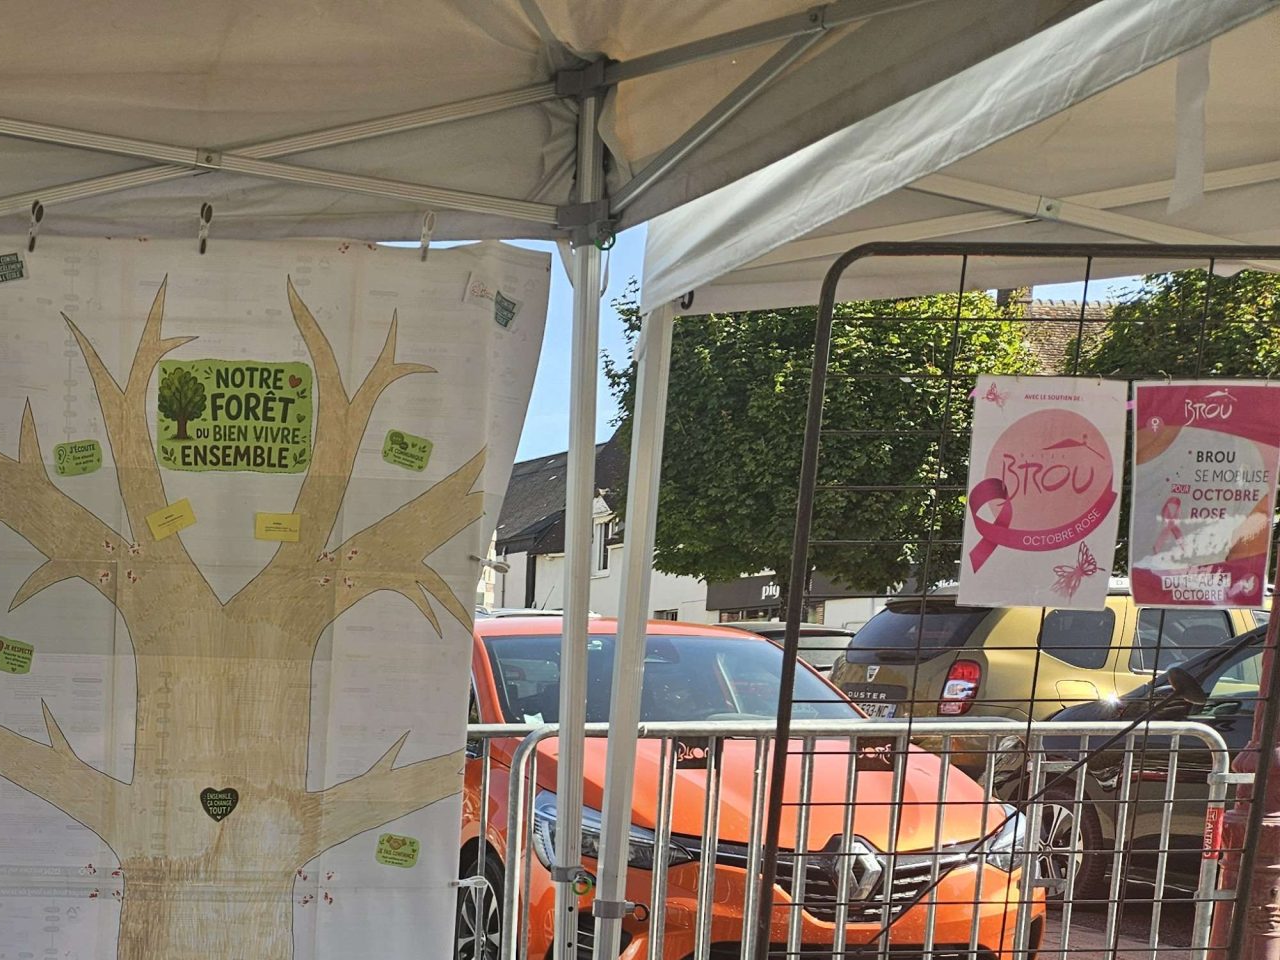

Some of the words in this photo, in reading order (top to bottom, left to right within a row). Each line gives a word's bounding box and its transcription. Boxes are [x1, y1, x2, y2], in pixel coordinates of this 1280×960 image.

[216, 367, 284, 390] NOTRE
[211, 391, 295, 423] FORÊT
[1184, 400, 1234, 426] BROU
[196, 428, 209, 438] DU
[213, 425, 248, 442] BIEN
[253, 426, 301, 444] VIVRE
[181, 446, 289, 468] ENSEMBLE
[1196, 450, 1236, 464] BROU
[997, 453, 1094, 506] BROU
[1194, 470, 1210, 482] SE
[1212, 470, 1270, 482] MOBILISE
[1172, 484, 1190, 494] POUR
[1192, 488, 1259, 502] OCTOBRE
[1190, 508, 1226, 520] ROSE
[1023, 528, 1074, 546] OCTOBRE
[1076, 508, 1102, 532] ROSE
[1174, 590, 1222, 600] OCTOBRE
[848, 691, 886, 700] DUSTER
